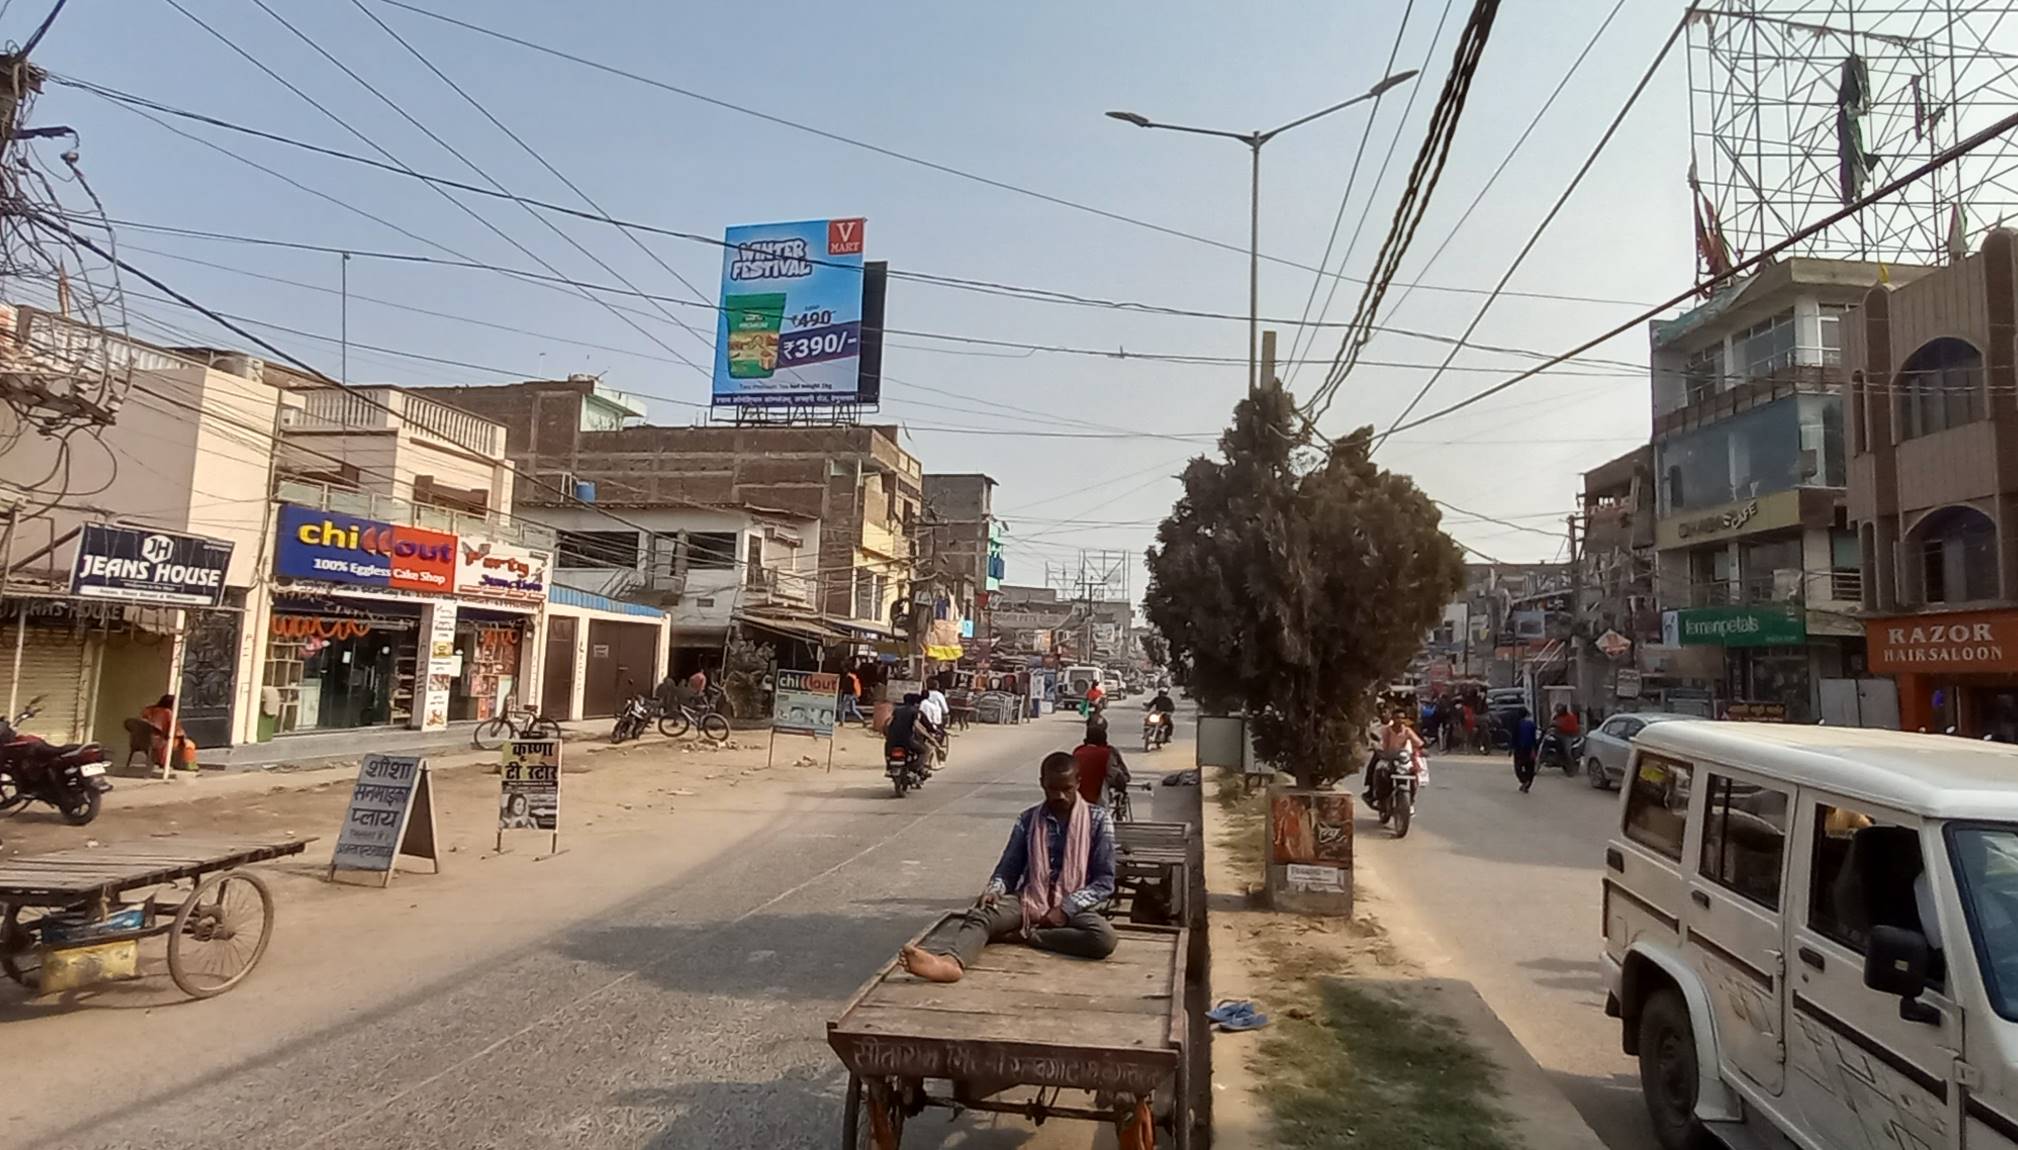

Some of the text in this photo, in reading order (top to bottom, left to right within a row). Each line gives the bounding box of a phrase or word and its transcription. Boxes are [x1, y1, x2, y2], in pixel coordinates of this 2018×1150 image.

[836, 222, 856, 243] V
[739, 238, 806, 262] WINTER
[830, 242, 860, 253] MART
[731, 258, 812, 280] FESTIVAL
[783, 331, 857, 360] ₹390/-
[1732, 500, 1758, 529] CAFE
[79, 555, 222, 587] JEANS HOUSE
[313, 557, 447, 586] 100% Eggless Cake Shop
[1887, 623, 1994, 645] RAZOR
[1883, 646, 2003, 662] HAIRSALOON
[511, 742, 554, 762] कृष्णा
[505, 761, 522, 780] टी
